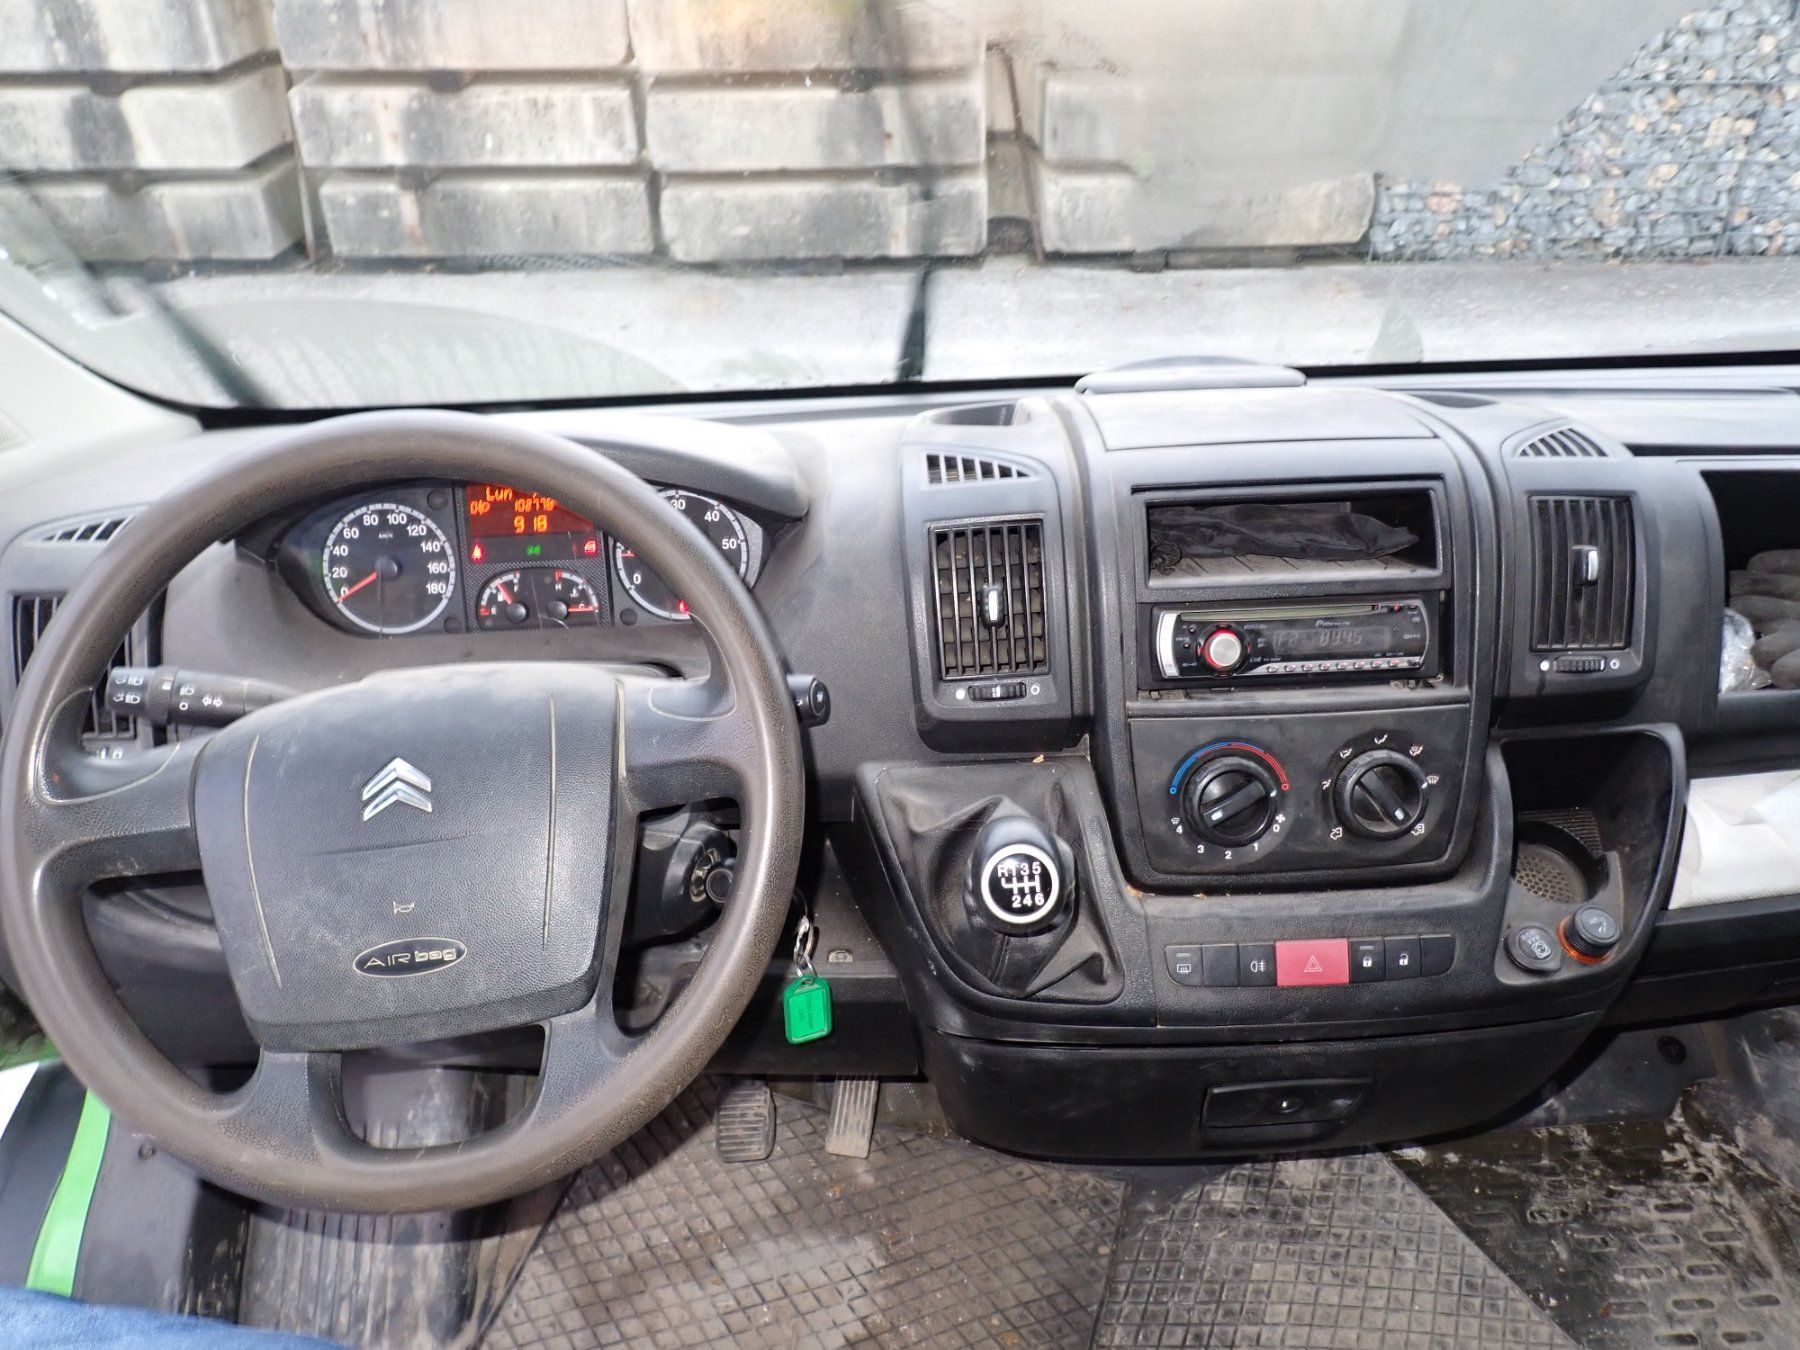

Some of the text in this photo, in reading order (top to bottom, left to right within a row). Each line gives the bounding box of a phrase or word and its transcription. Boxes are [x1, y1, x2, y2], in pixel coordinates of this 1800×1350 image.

[671, 499, 686, 510] 30
[363, 514, 379, 526] 80
[386, 513, 407, 525] 100
[704, 510, 720, 522] 40
[343, 527, 359, 539] 60
[406, 525, 427, 536] 120
[421, 541, 440, 553] 140
[722, 538, 737, 550] 50
[332, 545, 348, 556] 40
[332, 567, 348, 578] 20
[427, 562, 447, 574] 160
[633, 573, 642, 585] 0
[340, 586, 349, 598] 0
[426, 583, 446, 595] 180
[1176, 825, 1183, 834] 4
[1273, 824, 1280, 832] 0
[1197, 845, 1204, 853] 3
[1253, 842, 1258, 851] 1
[1225, 851, 1232, 859] 2
[997, 864, 1009, 877] R
[1020, 863, 1029, 876] 3
[1032, 862, 1041, 875] 5
[1012, 893, 1044, 908] 2 4 6
